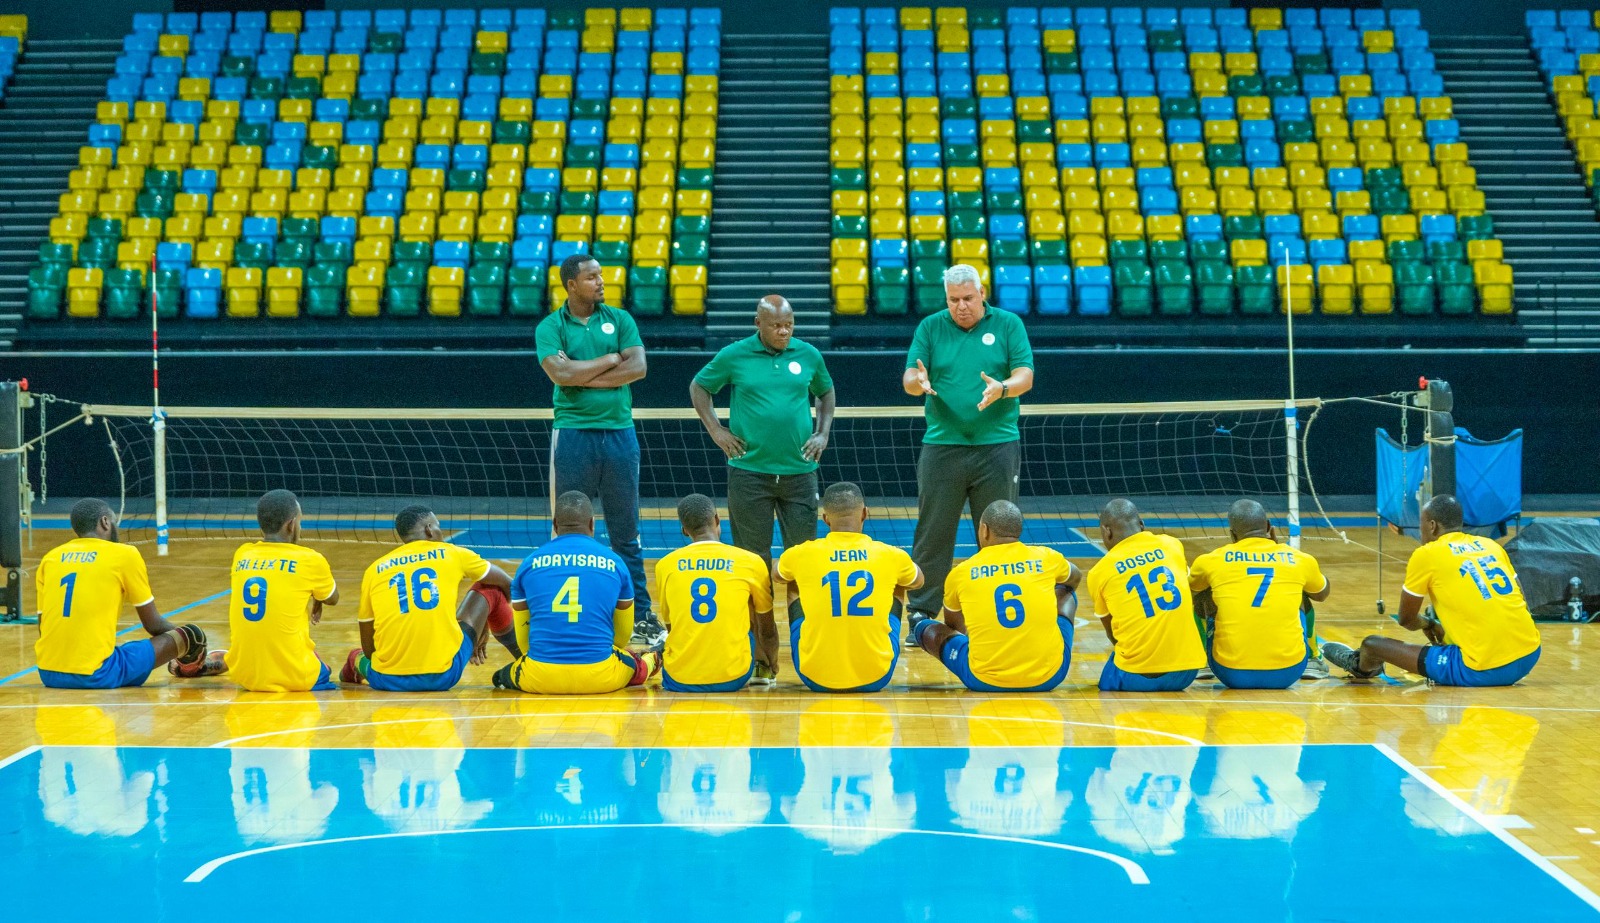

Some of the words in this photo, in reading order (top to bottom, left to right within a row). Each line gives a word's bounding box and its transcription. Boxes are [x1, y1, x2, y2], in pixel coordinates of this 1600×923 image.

[60, 551, 98, 563] VITUS
[377, 550, 447, 574] INNOCENT
[677, 558, 735, 572] CLAUDE
[829, 549, 868, 562] JEAN
[970, 559, 1045, 580] BAPTISTE
[1115, 548, 1166, 575] BOSCO
[1225, 551, 1295, 564] CALLIXTE
[1459, 555, 1514, 600] 15
[60, 572, 77, 618] 1
[242, 576, 267, 622] 9
[388, 567, 440, 614] 16
[551, 576, 583, 623] 4
[690, 577, 718, 623] 8
[821, 570, 874, 617] 12
[994, 583, 1026, 629] 6
[1125, 565, 1182, 619] 13
[1246, 567, 1275, 608] 7
